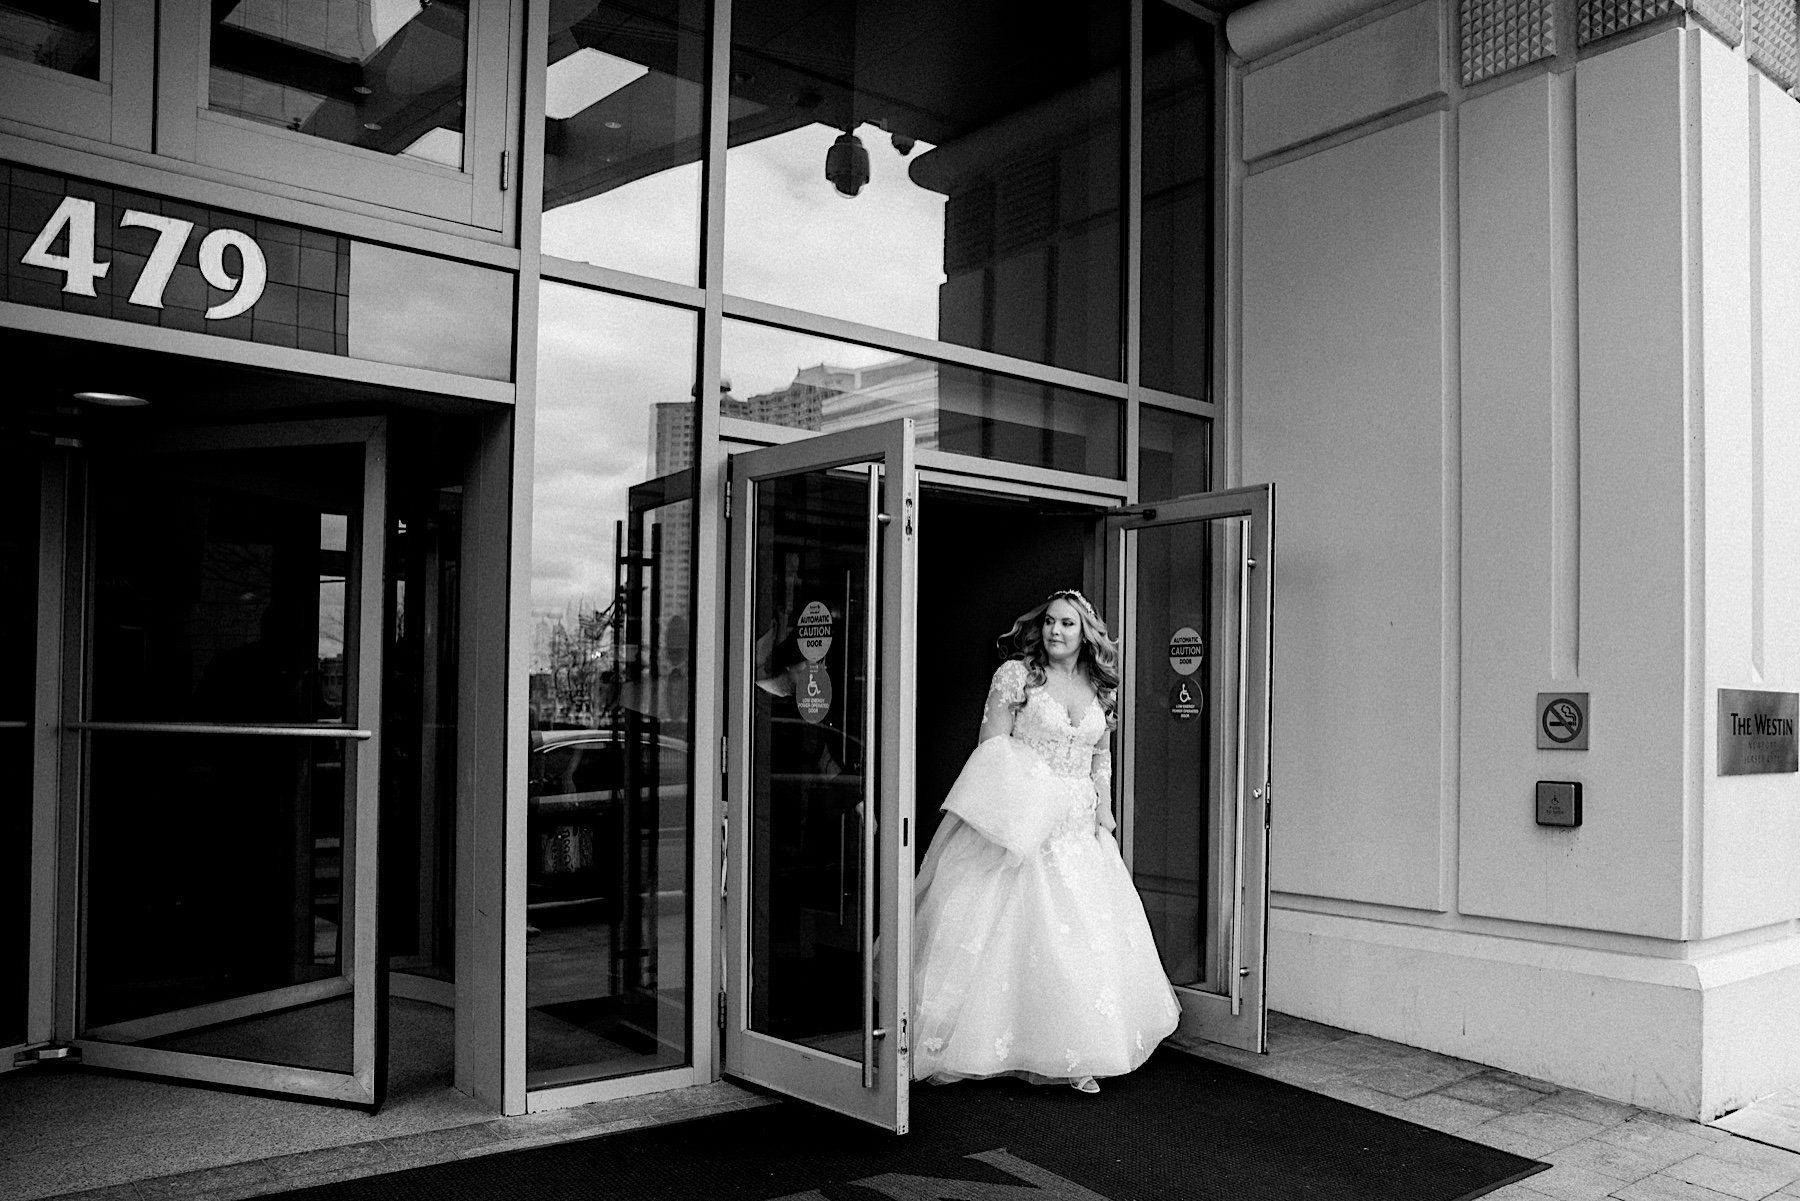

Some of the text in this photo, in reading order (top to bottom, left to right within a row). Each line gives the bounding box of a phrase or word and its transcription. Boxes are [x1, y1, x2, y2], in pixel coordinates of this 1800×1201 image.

[20, 195, 268, 320] 479
[801, 615, 829, 624] AUTOMATIC
[799, 625, 831, 637] CAUTION
[1171, 646, 1201, 656] CAUTION
